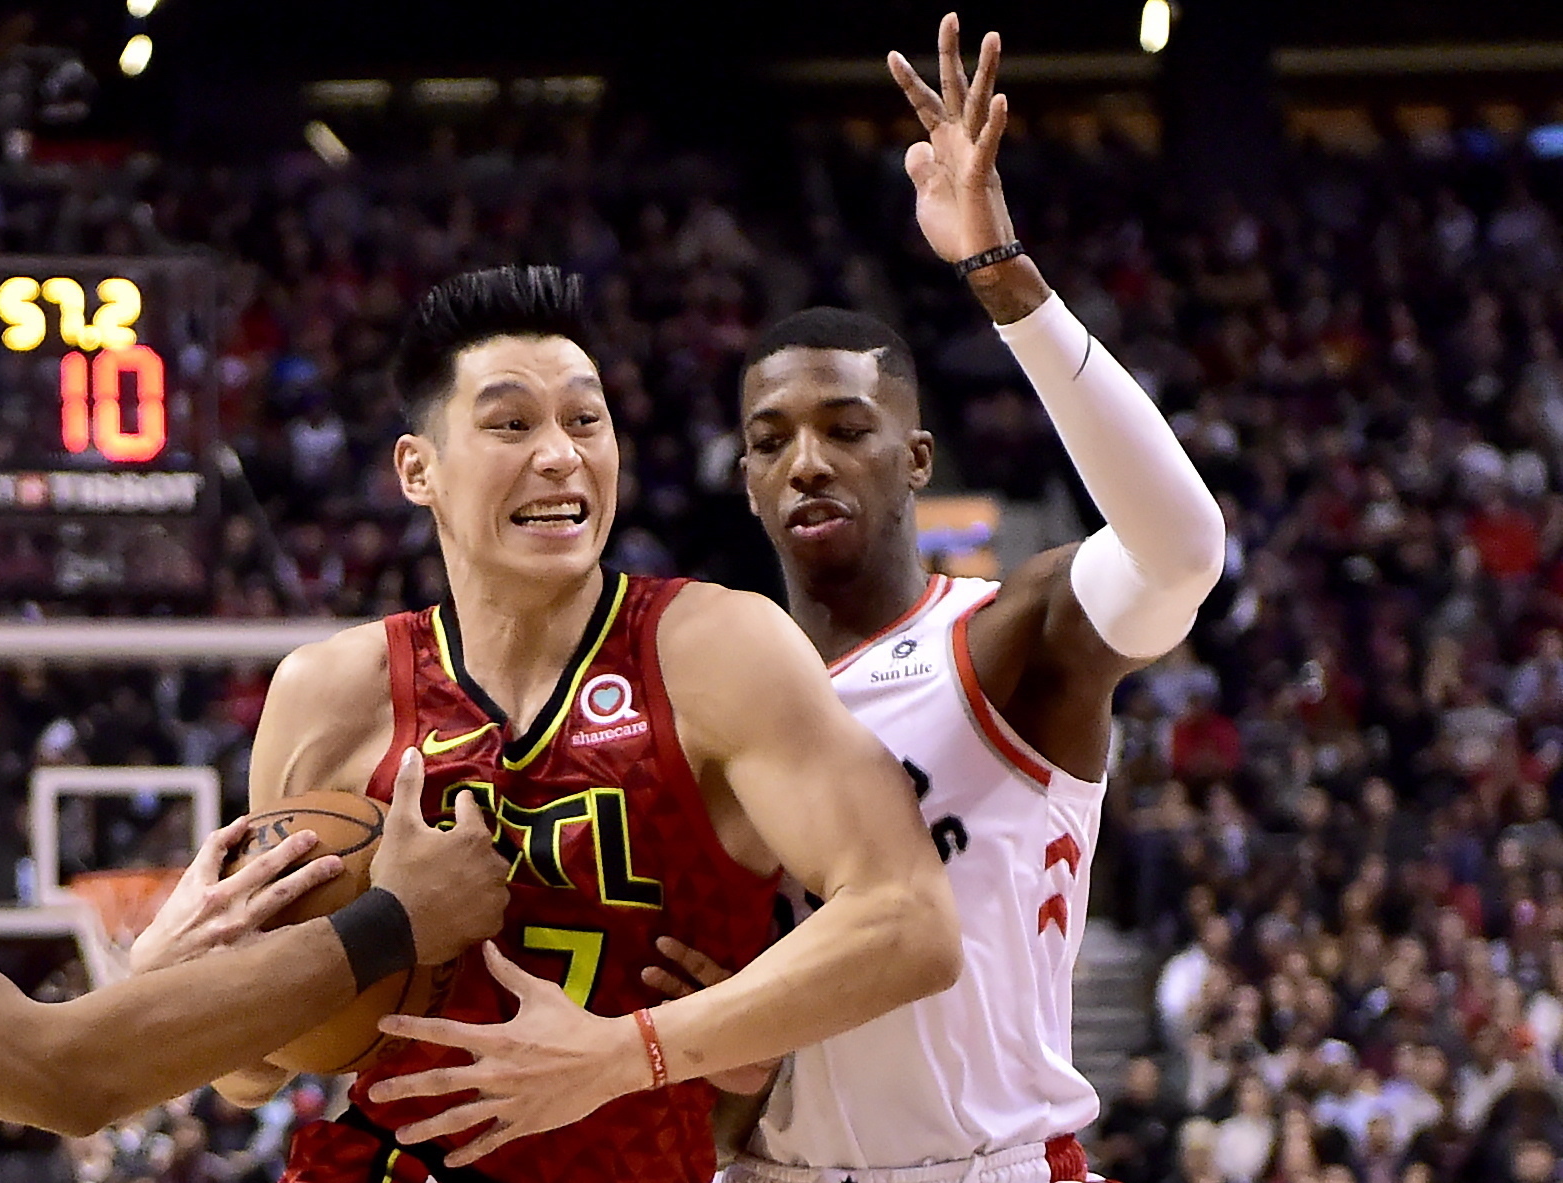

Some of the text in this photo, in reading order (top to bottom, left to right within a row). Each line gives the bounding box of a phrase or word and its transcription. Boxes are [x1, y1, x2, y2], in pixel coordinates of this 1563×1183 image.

[60, 344, 167, 463] 10
[869, 663, 933, 683] Sun Life
[571, 720, 649, 746] sharecare
[523, 925, 604, 1008] 7
